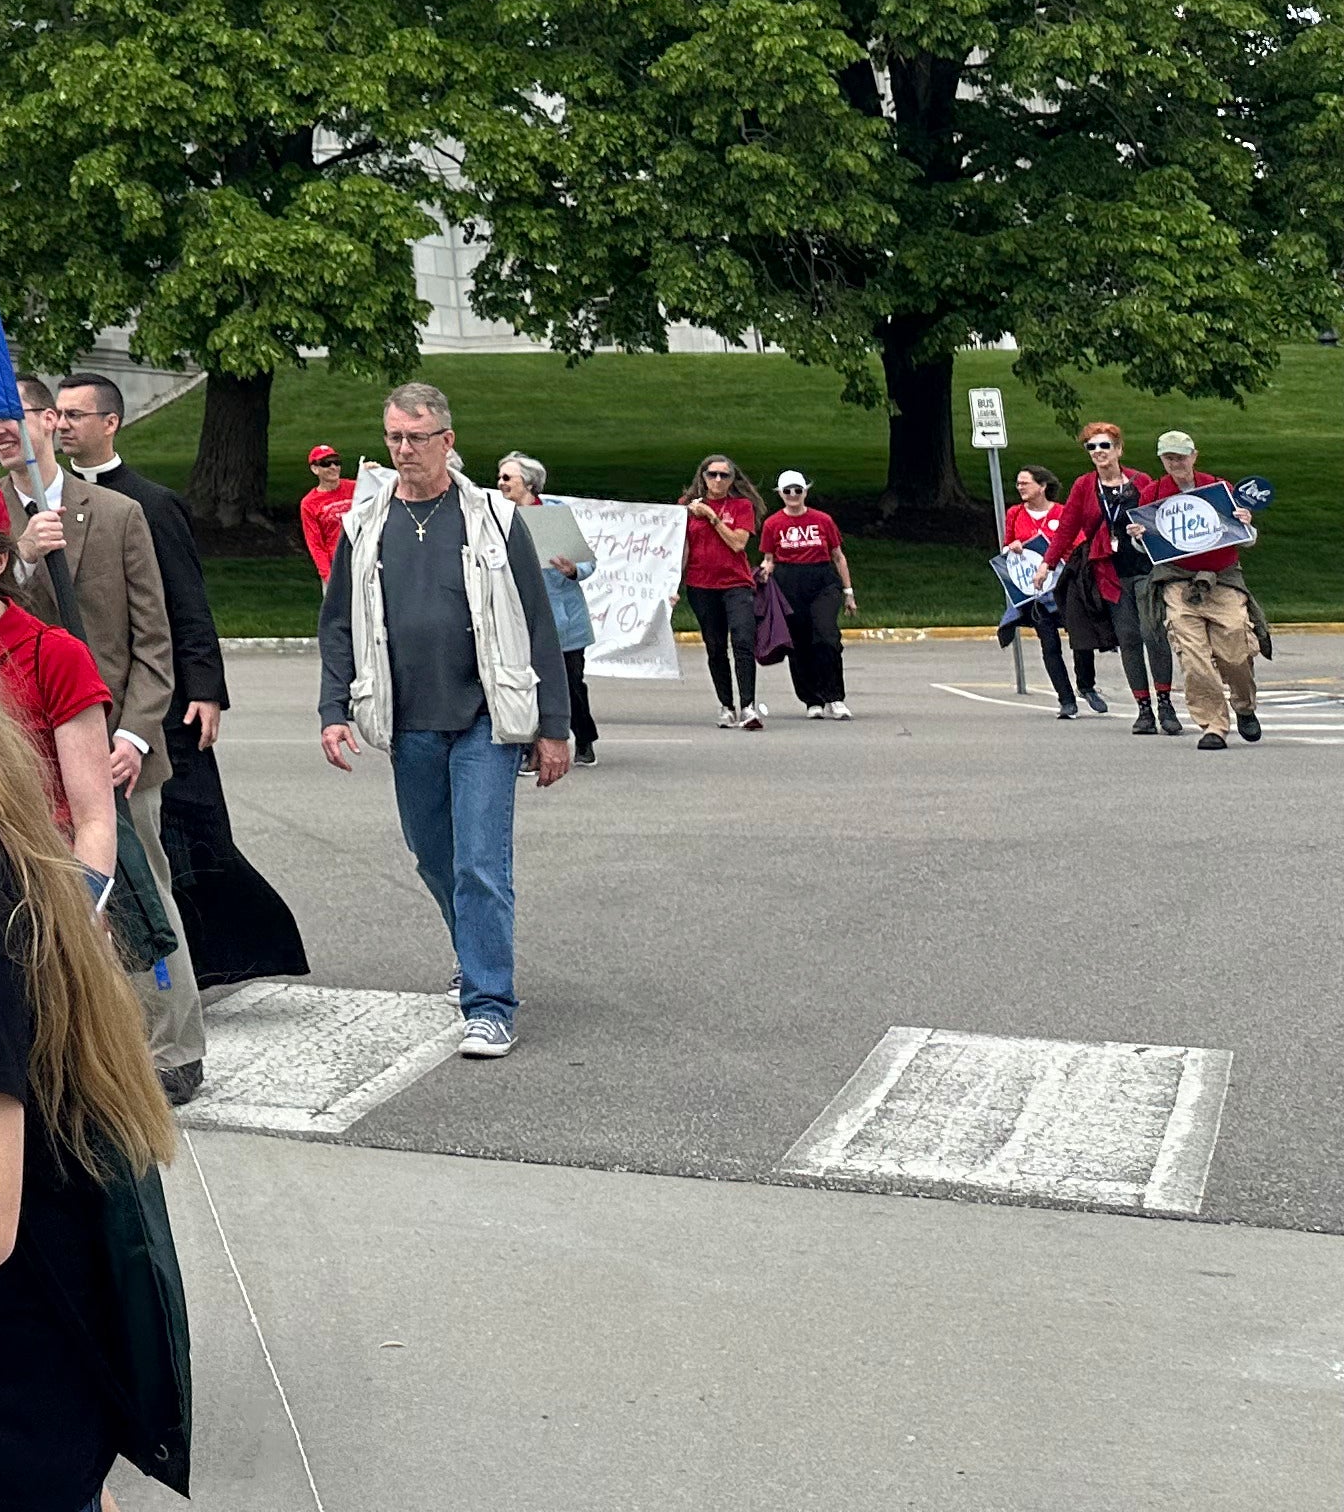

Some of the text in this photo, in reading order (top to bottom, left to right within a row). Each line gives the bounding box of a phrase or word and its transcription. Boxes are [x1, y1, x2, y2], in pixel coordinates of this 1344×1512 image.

[977, 398, 995, 408] BUS
[631, 512, 647, 526] TO
[779, 524, 820, 543] LOVE
[1168, 513, 1209, 545] Her
[604, 530, 674, 564] Mother
[586, 582, 655, 600] AYS TO BE
